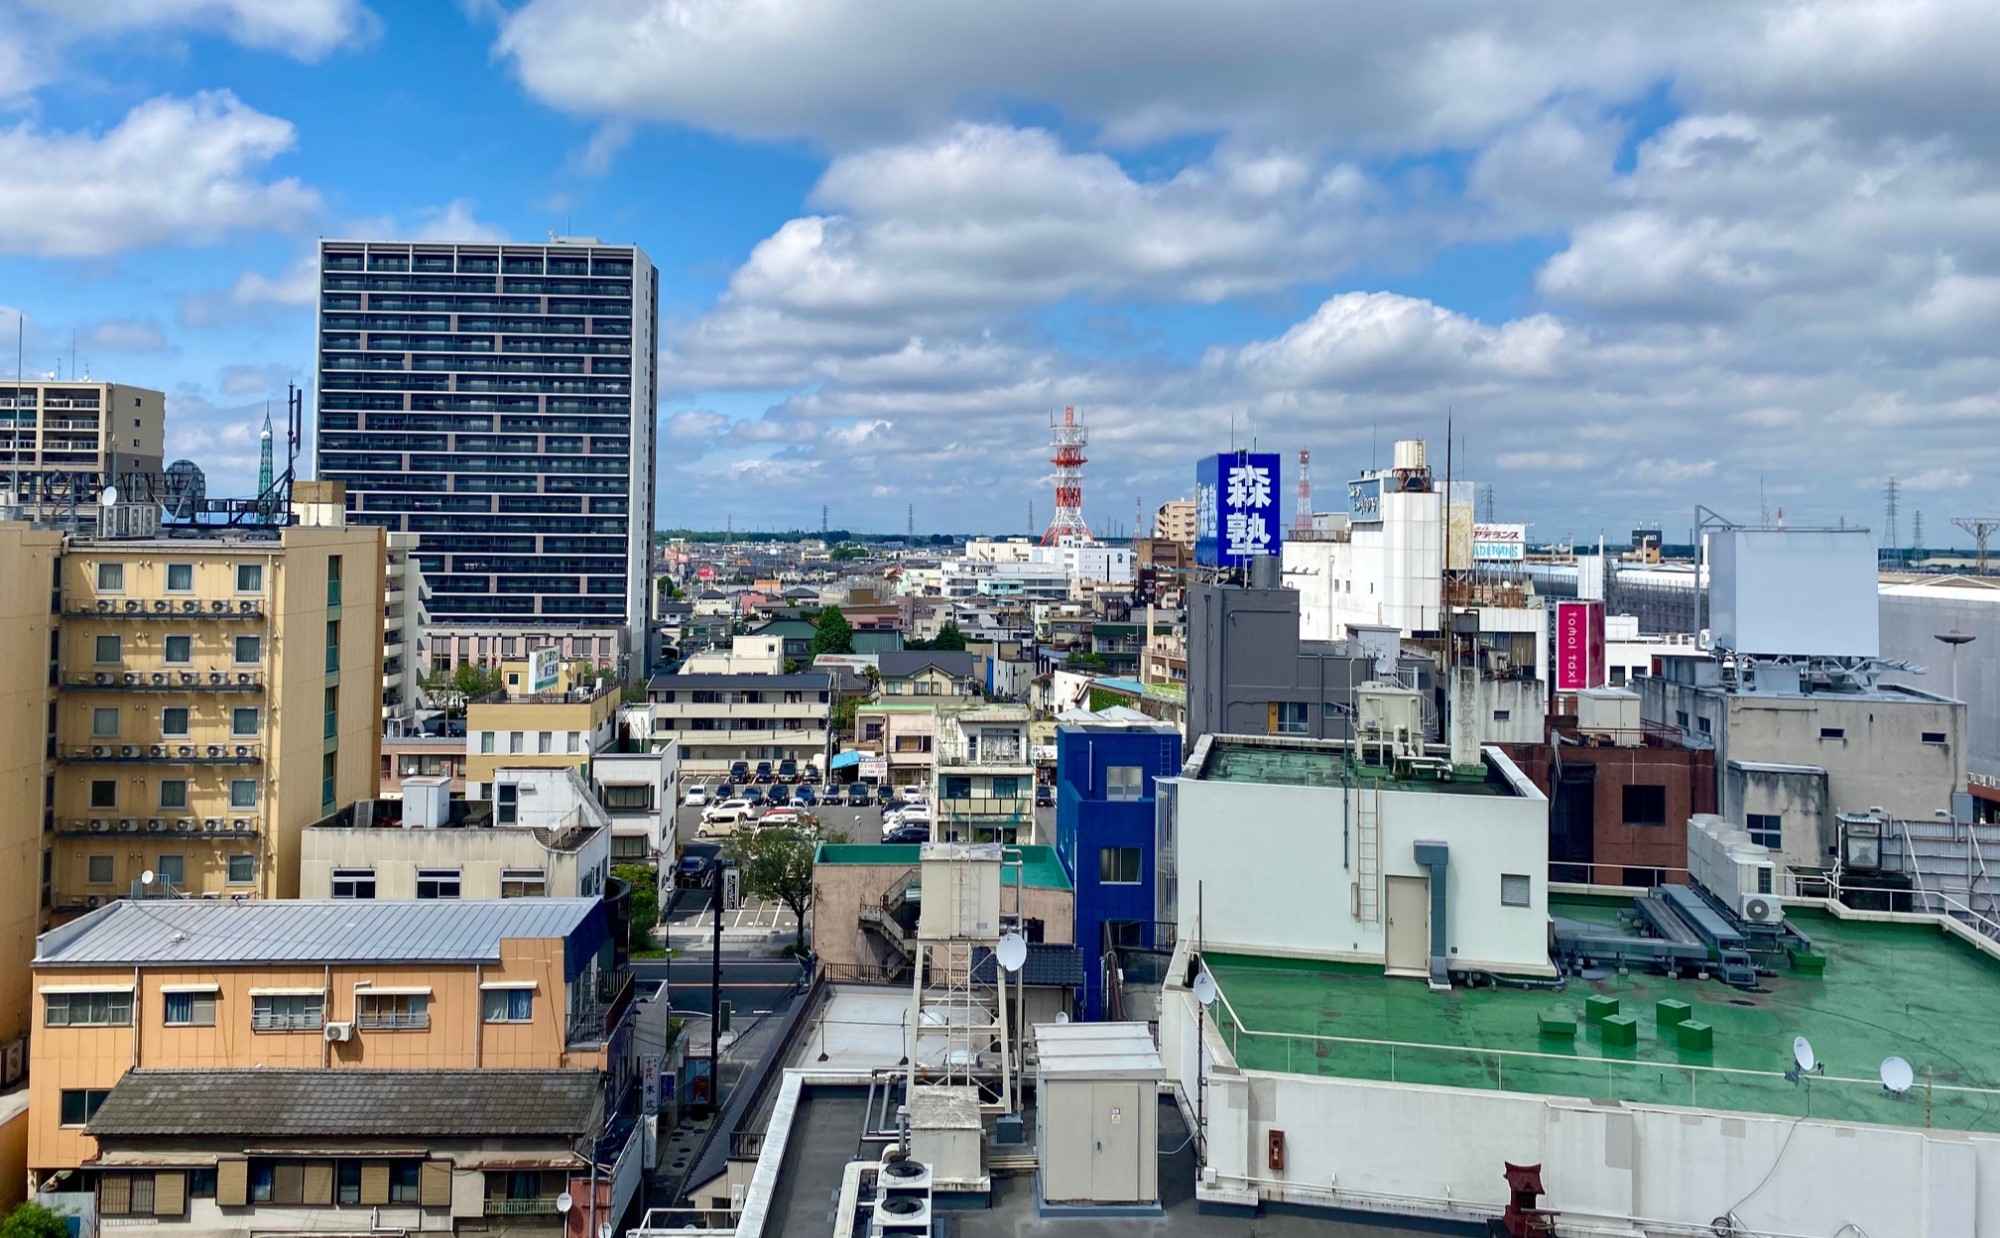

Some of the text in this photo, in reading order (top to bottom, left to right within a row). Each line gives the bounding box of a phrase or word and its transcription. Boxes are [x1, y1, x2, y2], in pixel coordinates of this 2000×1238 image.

[1226, 465, 1272, 555] 森塾
[1474, 531, 1519, 540] アデランス
[1474, 545, 1518, 557] ADERANS
[1568, 654, 1578, 683] taxi
